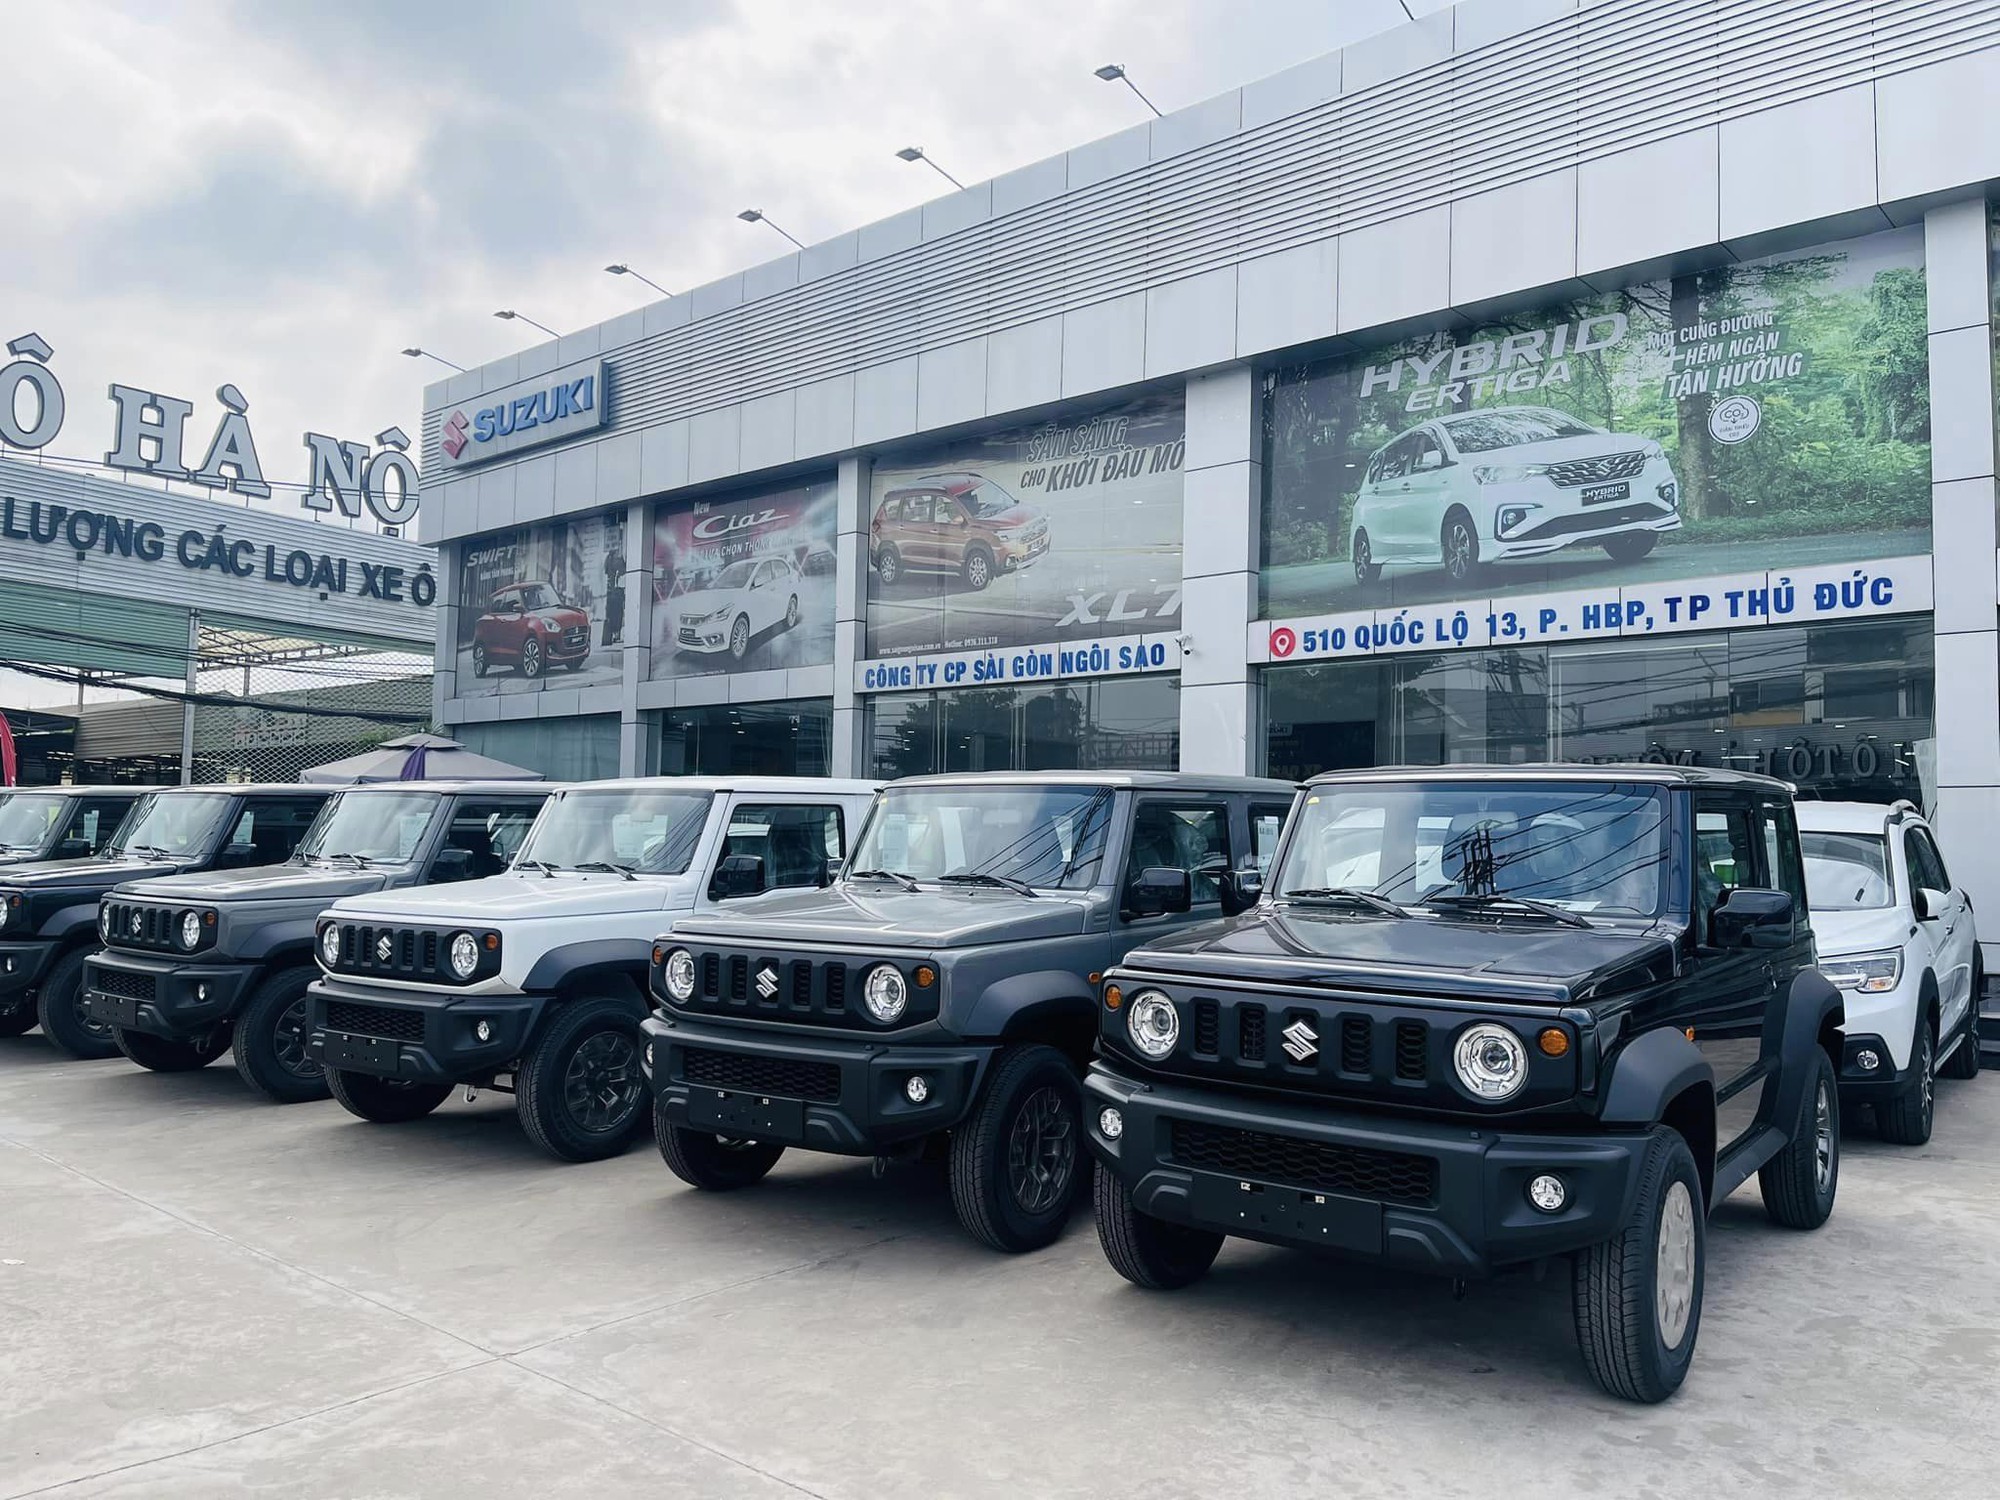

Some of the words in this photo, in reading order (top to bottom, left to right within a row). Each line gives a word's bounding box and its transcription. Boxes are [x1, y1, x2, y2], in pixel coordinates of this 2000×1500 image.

[1680, 321, 1717, 343] CUNG
[1720, 311, 1774, 336] ĐƯỜNG
[1728, 330, 1780, 360] NGÀN
[1359, 312, 1627, 398] HYBRID
[1668, 368, 1711, 400] TẬN
[1716, 352, 1803, 390] HƯỞNG
[473, 374, 594, 443] SUZUKI
[1404, 361, 1571, 412] ERTIGA
[104, 383, 271, 498] HÀ
[1071, 415, 1130, 454] SÀNG
[1020, 467, 1046, 489] CHO
[1045, 451, 1100, 493] KHỞI
[1101, 443, 1147, 483] ĐẦU
[693, 508, 790, 538] Ciaz
[3, 497, 165, 561] LƯỢNG
[177, 524, 255, 577] CÁC
[265, 545, 347, 600] LOẠI
[358, 562, 403, 601] XE
[411, 563, 436, 607] Ô
[467, 544, 516, 567] SWIFT
[1054, 582, 1182, 627] XL7
[1303, 628, 1346, 653] 510
[1354, 610, 1424, 651] QUỐC
[1436, 611, 1468, 646] LỘ
[1486, 611, 1526, 641] 13,
[1539, 608, 1568, 635] P.
[1582, 600, 1654, 631] HBP,
[1664, 593, 1711, 623] TP
[1724, 576, 1795, 618] THỦ
[1813, 570, 1893, 611] ĐỨC
[865, 664, 911, 689] CÔNG
[916, 663, 937, 683] TY
[944, 660, 966, 683] CP
[973, 653, 1004, 680] SÀI
[1013, 650, 1051, 678] GÒN
[1060, 644, 1109, 674] NGÔI
[1119, 643, 1165, 668] SAO
